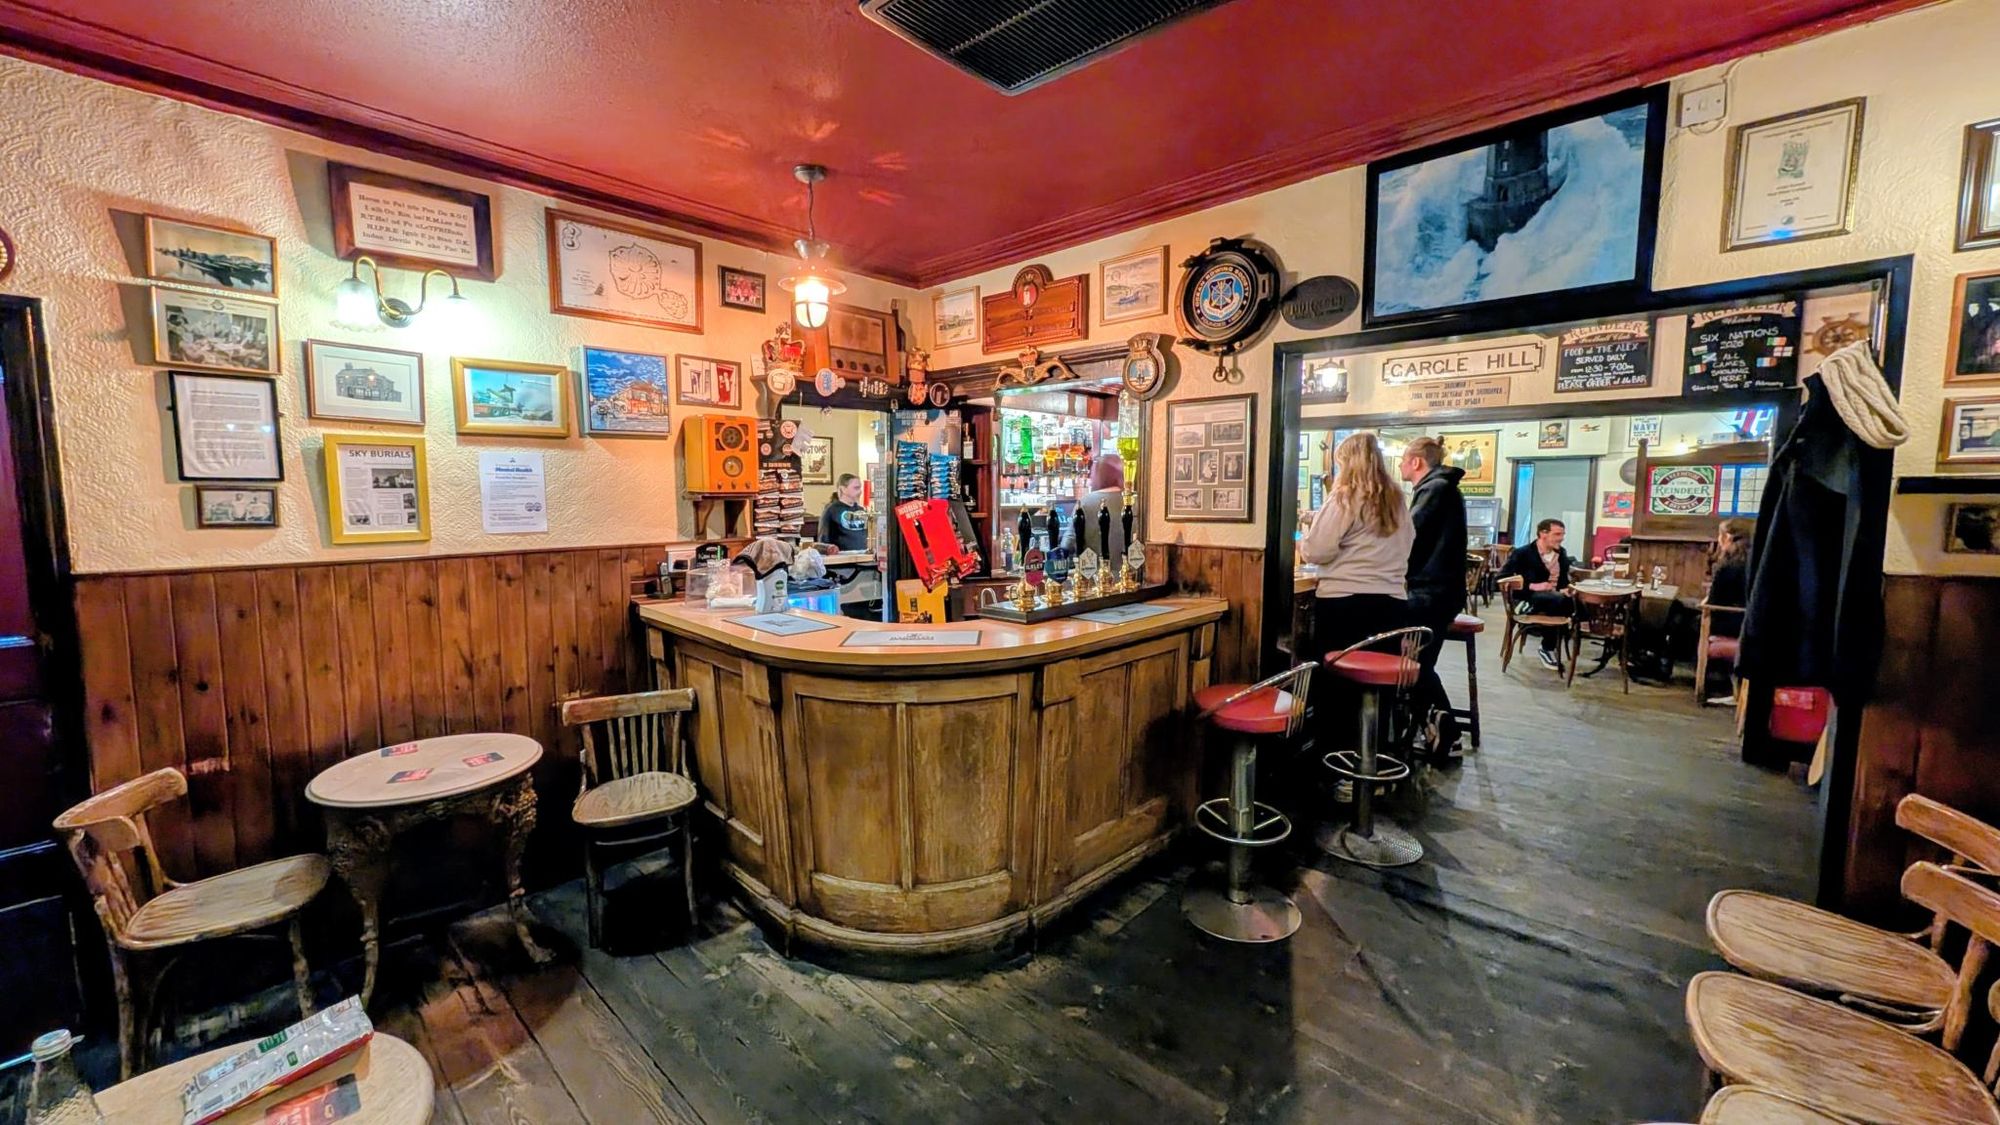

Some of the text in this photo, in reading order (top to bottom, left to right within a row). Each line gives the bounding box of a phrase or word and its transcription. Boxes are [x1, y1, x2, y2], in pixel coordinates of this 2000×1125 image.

[1700, 326, 1779, 344] SIX NATIONS
[1564, 347, 1584, 357] FOOD
[1596, 345, 1612, 354] THE
[1487, 350, 1534, 369] HILL
[1576, 353, 1627, 365] SERVED DAILY
[1558, 380, 1584, 390] PLEASE
[1586, 378, 1611, 388] ORDER
[1632, 375, 1647, 384] BAR
[1633, 422, 1658, 431] NAVY
[348, 450, 411, 458] SKY BURIALS
